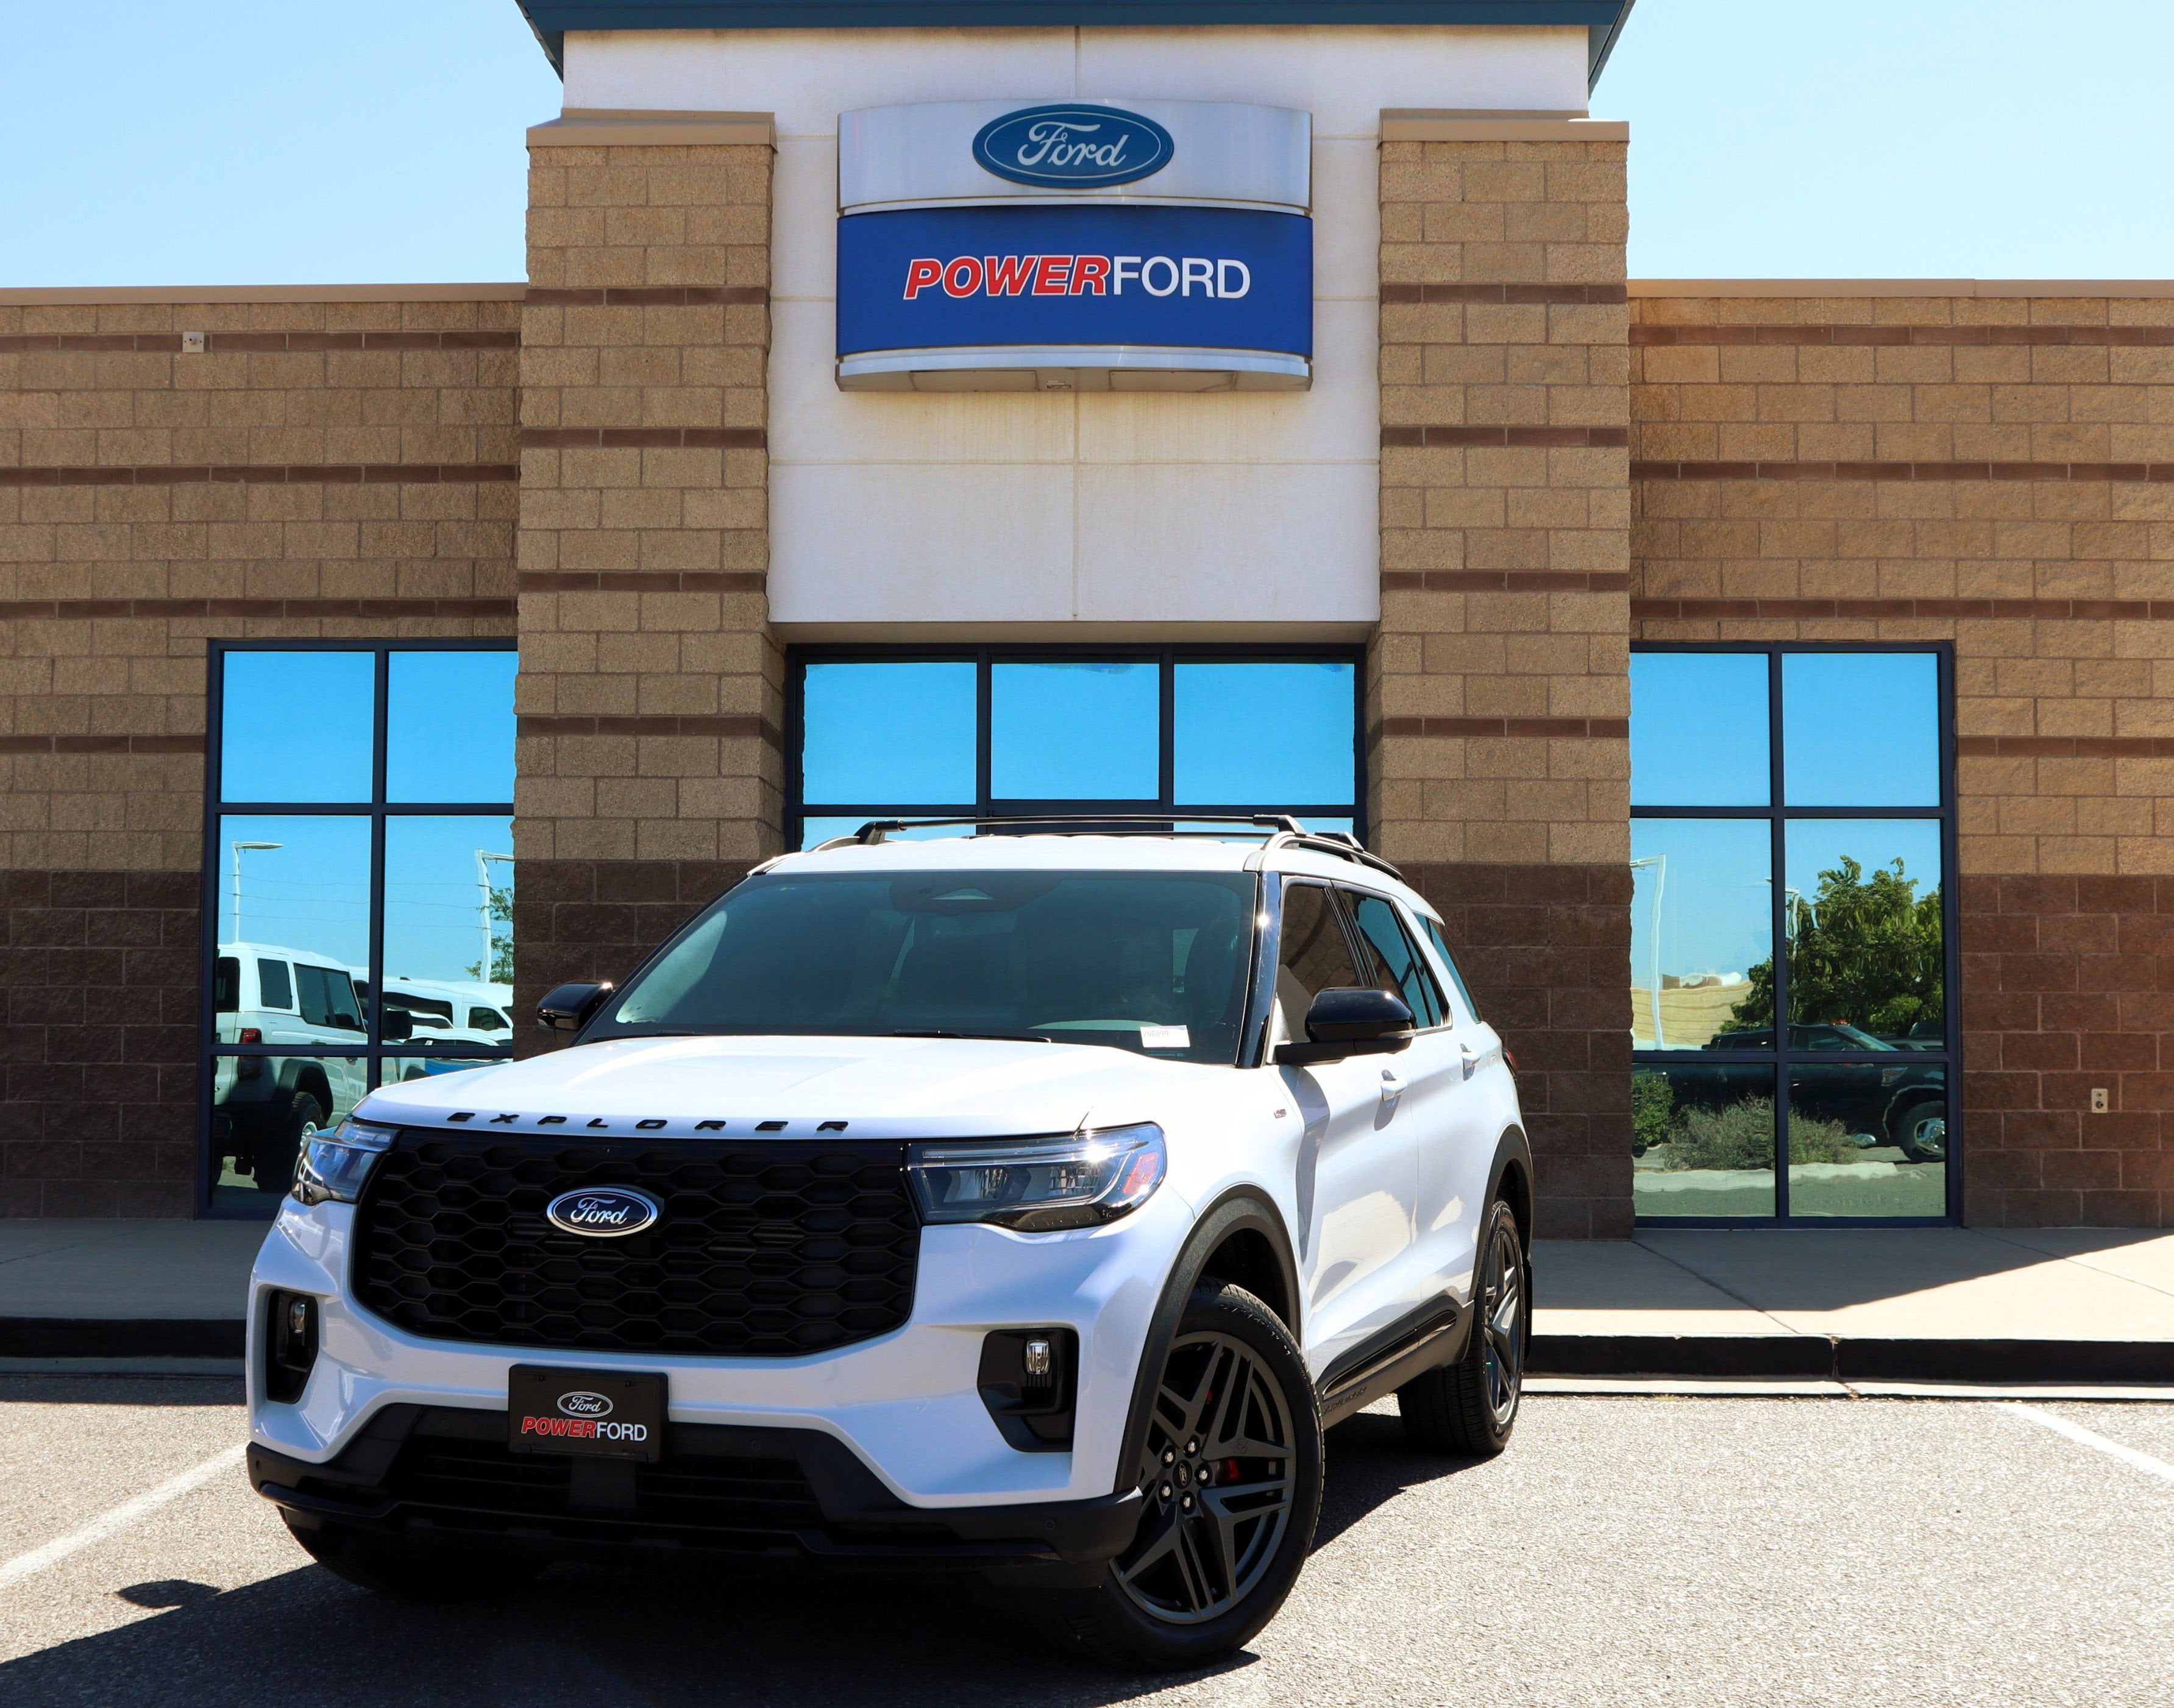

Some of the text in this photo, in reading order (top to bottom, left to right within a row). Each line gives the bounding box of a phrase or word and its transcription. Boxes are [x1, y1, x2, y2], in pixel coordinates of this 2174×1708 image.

[1017, 121, 1129, 167] Ford
[903, 255, 1251, 300] POWERFORD
[446, 1112, 850, 1132] EXPLORER
[570, 1197, 630, 1225] Ford
[568, 1395, 602, 1412] Ford
[521, 1416, 647, 1442] POWERFORD
